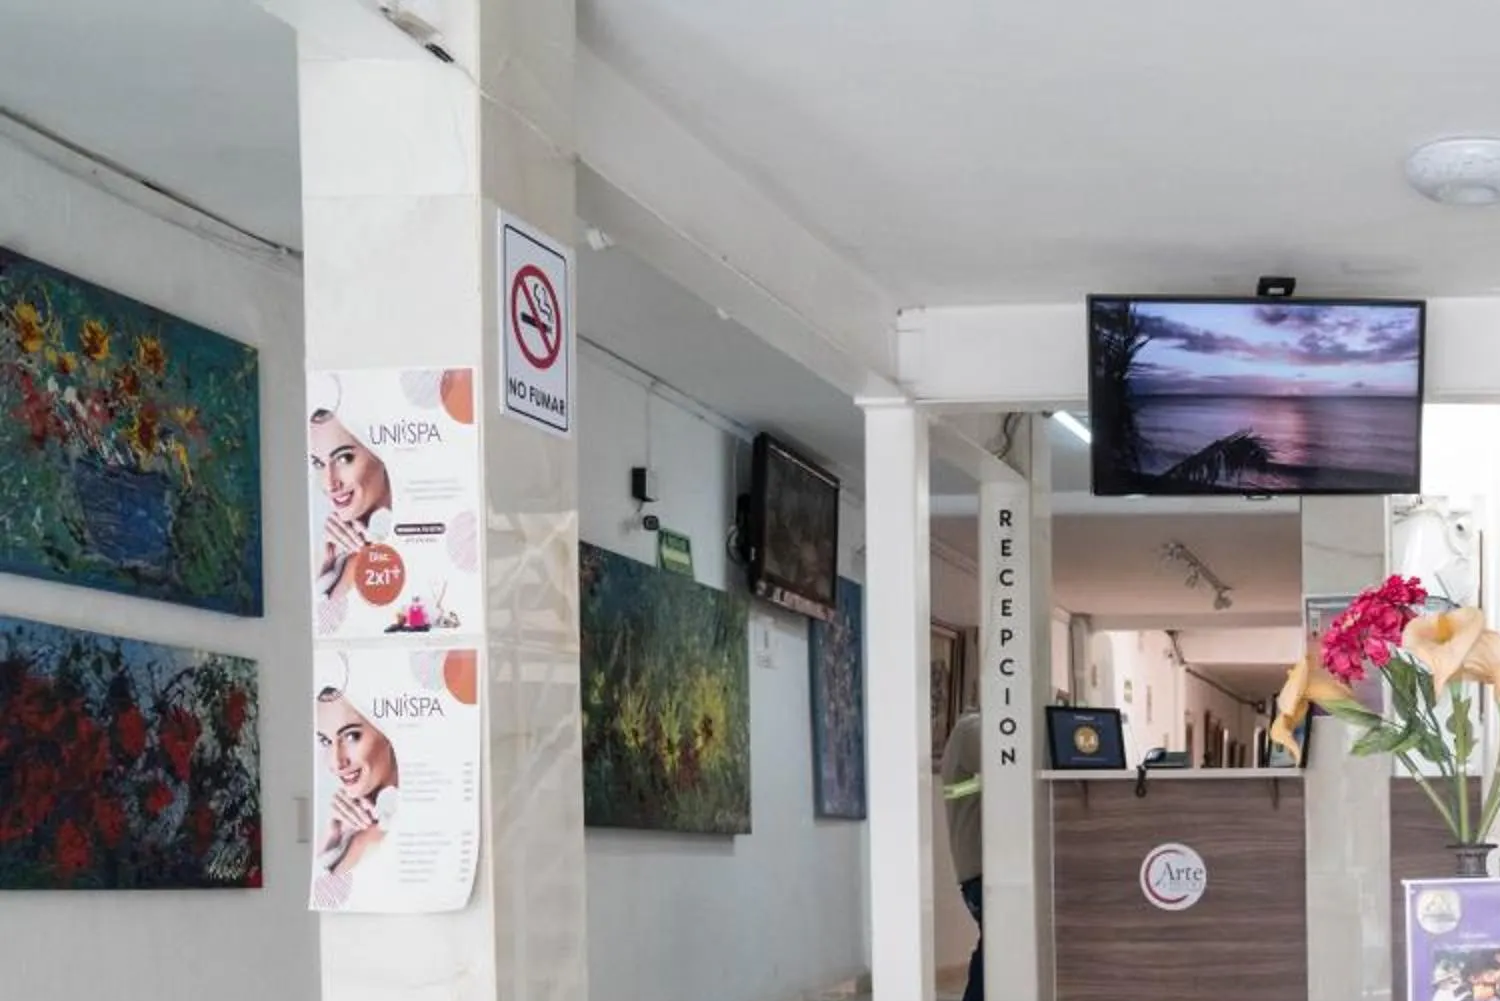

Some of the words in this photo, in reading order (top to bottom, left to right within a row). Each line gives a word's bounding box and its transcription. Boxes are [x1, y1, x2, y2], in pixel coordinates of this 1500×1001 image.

[509, 377, 527, 399] NO
[530, 386, 565, 416] FUMAR
[999, 509, 1017, 765] RECEPCION
[1155, 861, 1204, 886] Arte
